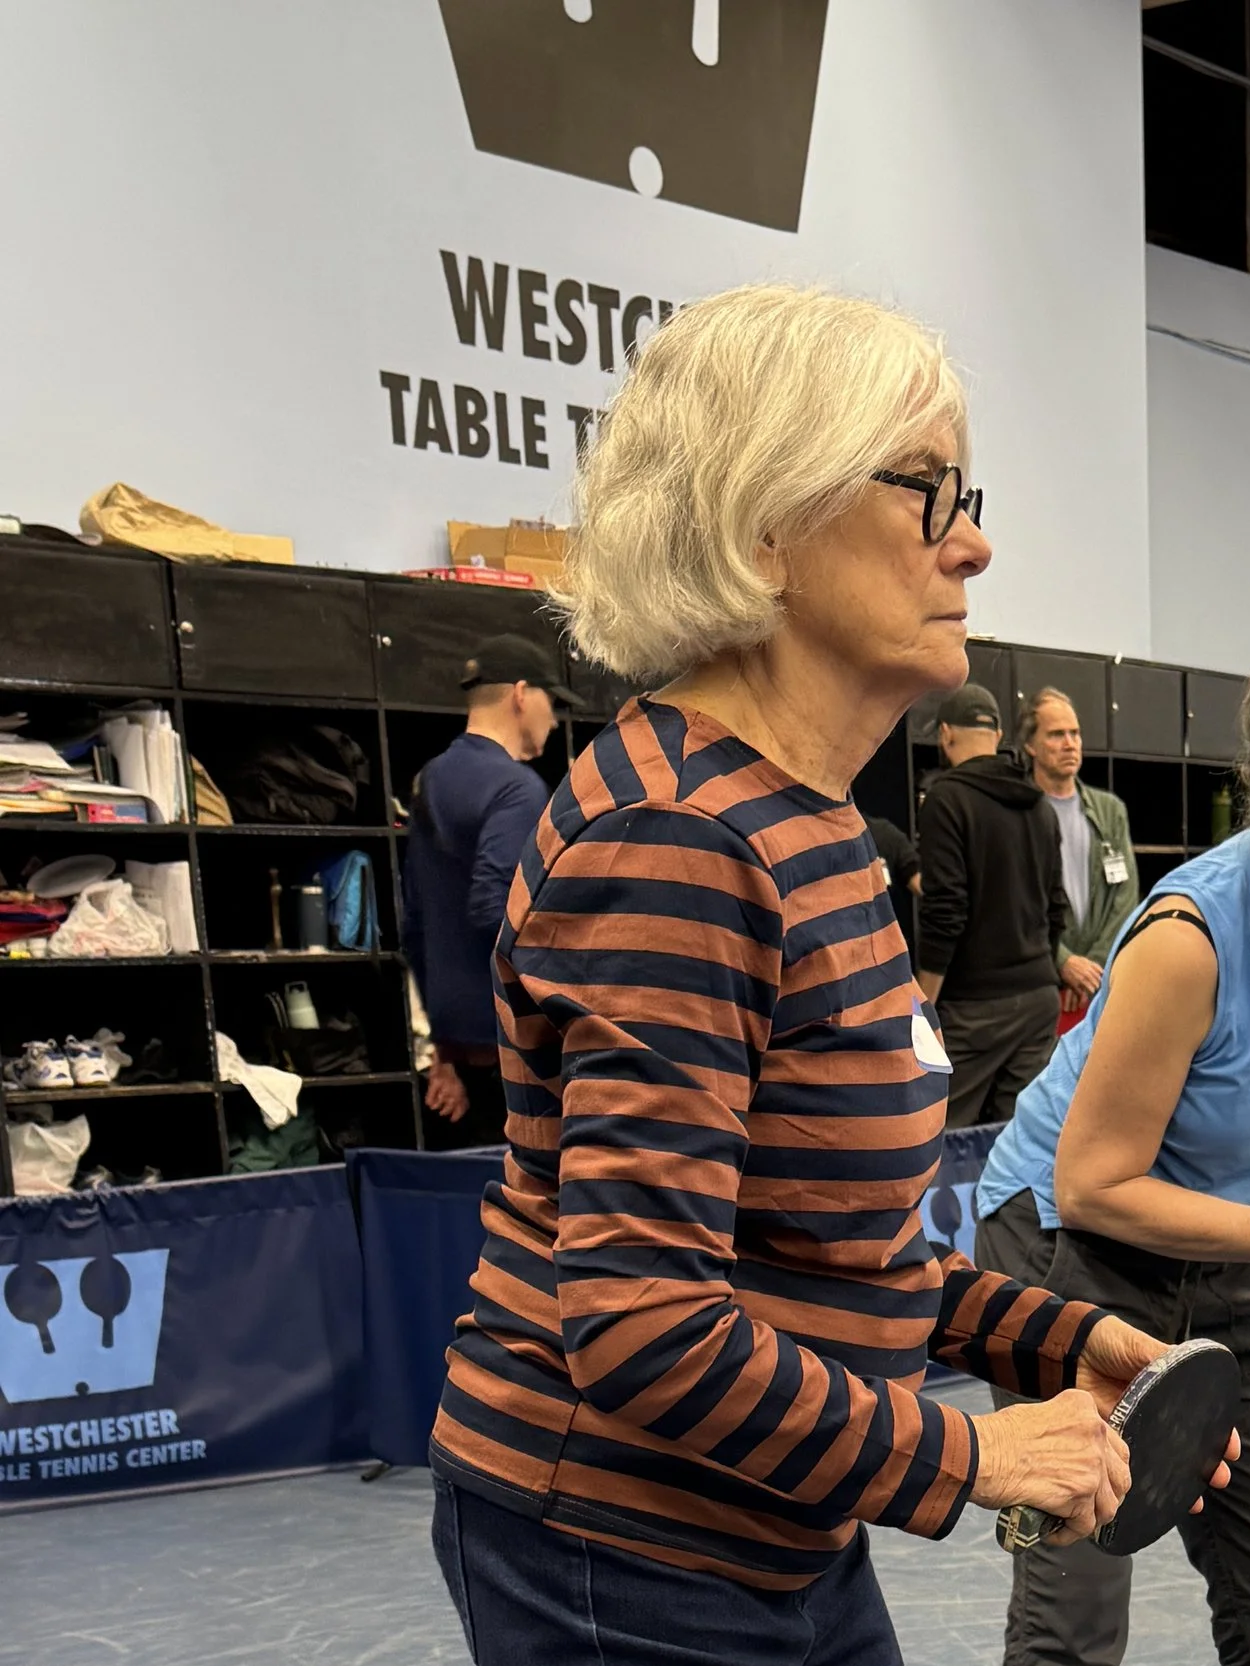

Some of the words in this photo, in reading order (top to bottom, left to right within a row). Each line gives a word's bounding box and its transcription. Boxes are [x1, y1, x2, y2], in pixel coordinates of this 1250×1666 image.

[439, 249, 686, 373] WESTC
[379, 369, 549, 470] TABLE
[38, 1451, 119, 1480] TENNIS
[126, 1439, 207, 1468] CENTER
